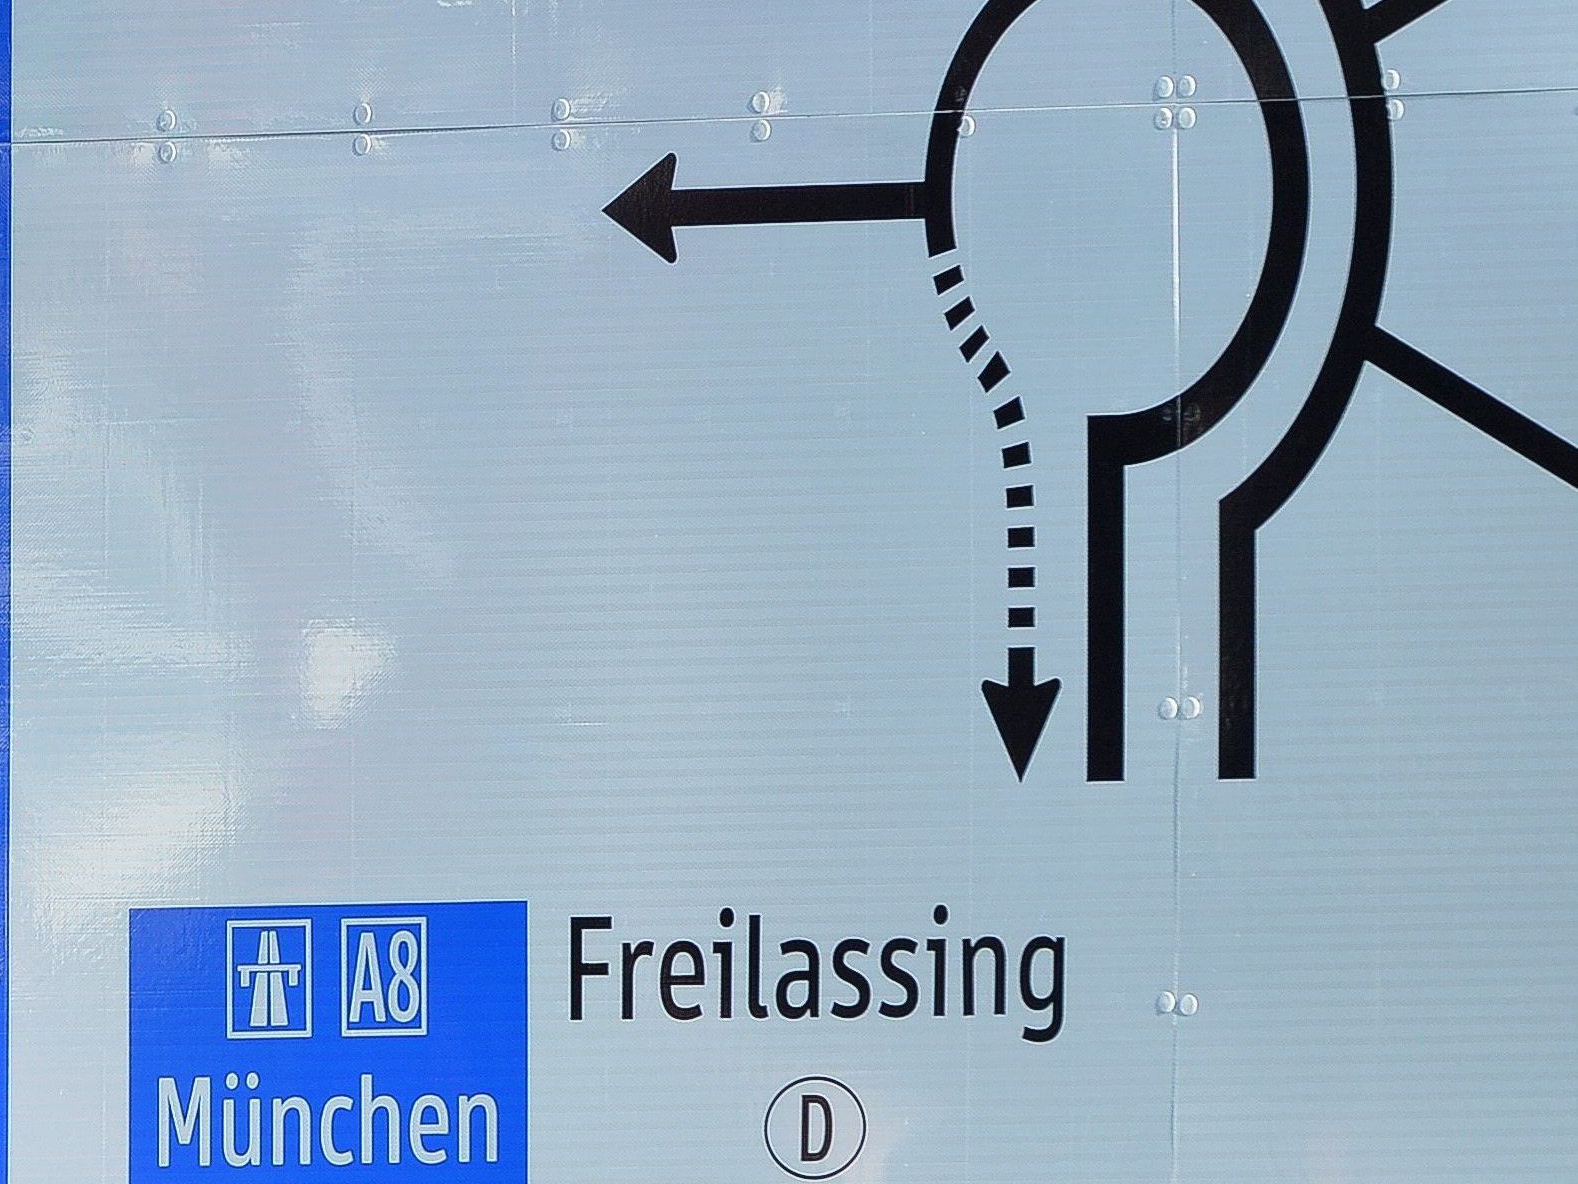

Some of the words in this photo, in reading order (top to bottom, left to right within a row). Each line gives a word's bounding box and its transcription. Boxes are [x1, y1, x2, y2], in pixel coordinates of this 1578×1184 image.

[348, 930, 420, 1024] A8
[569, 904, 1065, 1043] Freilassing
[158, 1072, 499, 1168] München
[800, 1094, 833, 1162] D
